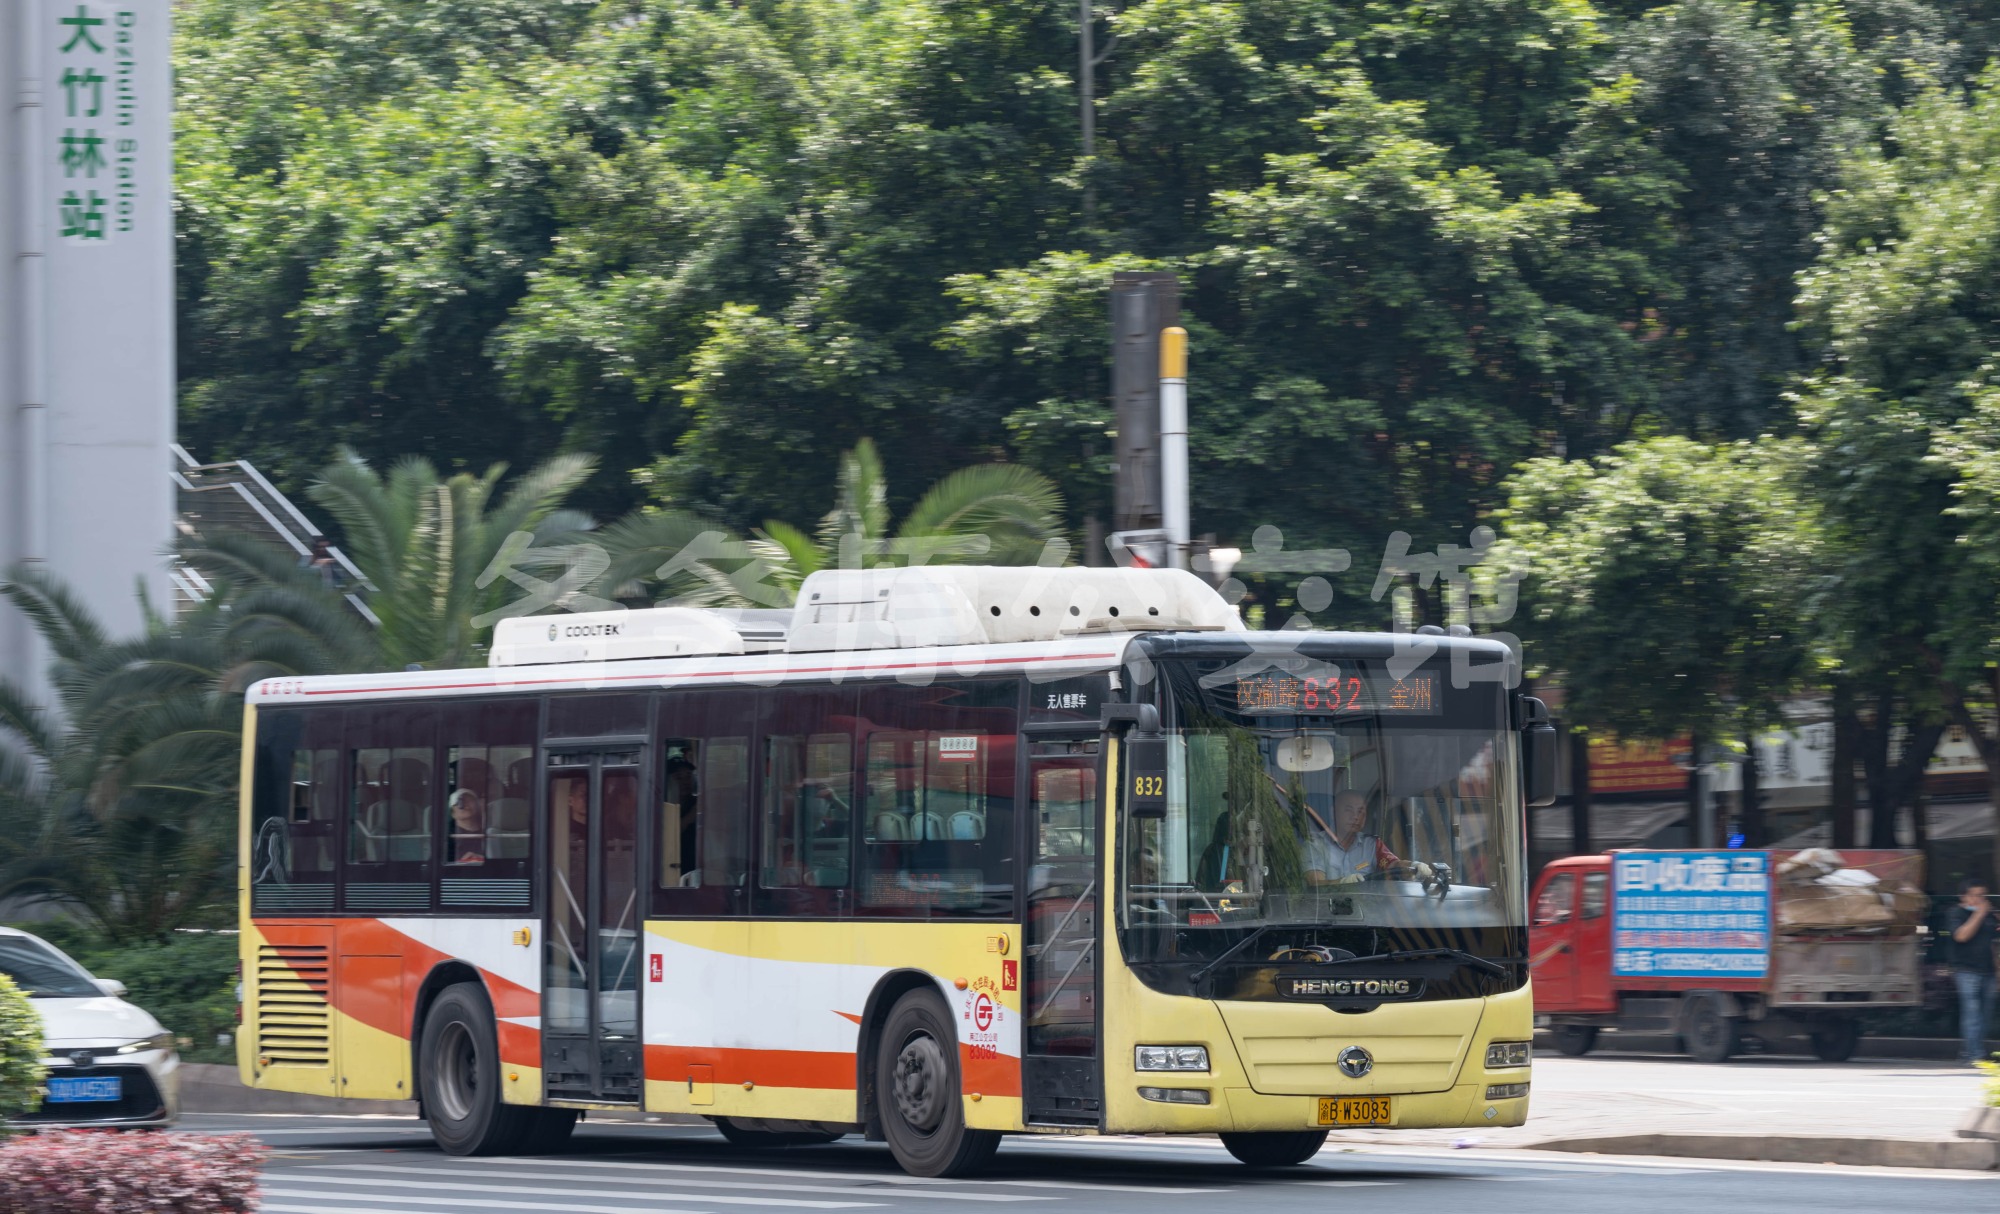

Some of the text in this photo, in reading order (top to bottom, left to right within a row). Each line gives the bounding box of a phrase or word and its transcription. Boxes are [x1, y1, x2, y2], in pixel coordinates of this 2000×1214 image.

[58, 5, 107, 240] 大竹林站
[115, 11, 138, 232] Dazhulin Station
[566, 624, 620, 638] COOLTEK
[1047, 693, 1087, 709] 无人售票车
[1237, 677, 1431, 710] 汉渝路 832 金州
[1135, 776, 1163, 796] 832
[1616, 856, 1768, 892] 回收废品
[1292, 978, 1410, 996] HENGTONG
[1320, 1101, 1389, 1121] 渝B·W3083
